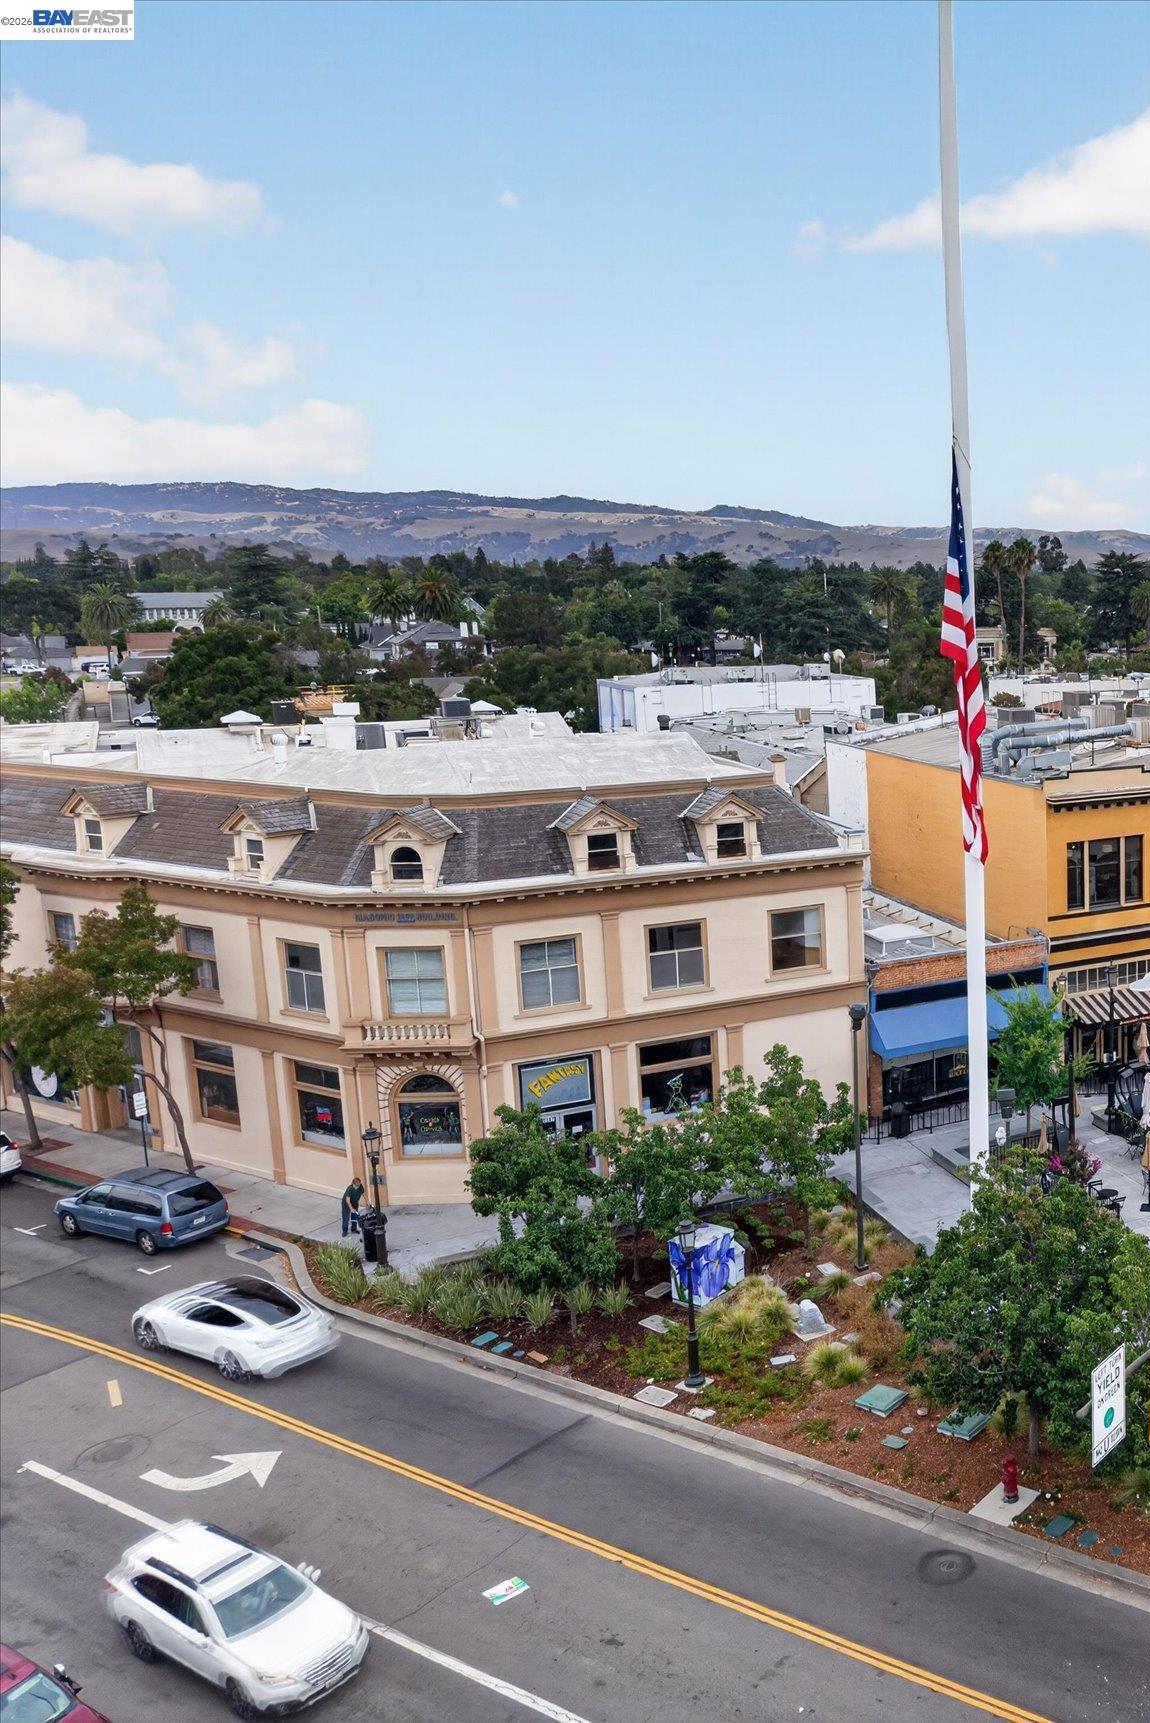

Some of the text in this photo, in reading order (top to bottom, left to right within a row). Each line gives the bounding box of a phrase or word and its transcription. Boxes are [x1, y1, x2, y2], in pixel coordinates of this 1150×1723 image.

[528, 1063, 584, 1098] FANTASY
[1095, 1353, 1122, 1383] LEFT TURN
[1097, 1366, 1120, 1394] YIELD
[1097, 1382, 1120, 1409] ON GREEN
[1103, 1436, 1110, 1452] U
